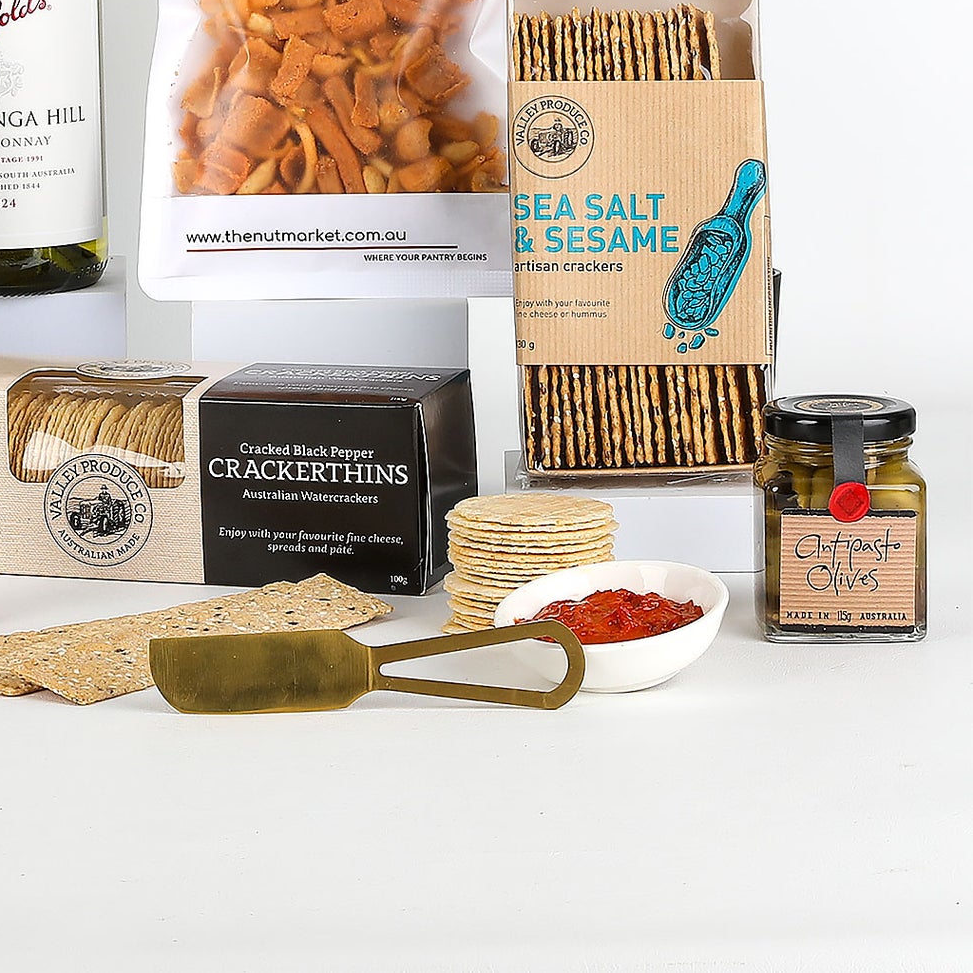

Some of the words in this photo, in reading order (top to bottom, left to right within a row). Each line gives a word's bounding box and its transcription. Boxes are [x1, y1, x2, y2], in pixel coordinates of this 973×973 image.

[47, 105, 86, 126] HILL
[515, 103, 540, 147] VALLEY
[539, 99, 588, 129] PRODUCE
[26, 155, 44, 163] 1991
[31, 167, 76, 178] AUSTRALIA
[22, 182, 41, 190] 1844
[514, 193, 576, 221] SEA
[585, 193, 665, 221] SALT
[186, 228, 407, 244] www.thenutmarket.com.au
[515, 226, 535, 253] &
[545, 226, 679, 253] SESAME
[363, 253, 394, 262] WHERE
[395, 253, 420, 262] YOUR
[421, 253, 456, 262] PANTRY
[457, 253, 488, 262] BEGINS
[514, 260, 559, 273] artisan
[563, 260, 624, 273] crackers
[515, 298, 535, 309] Enjoy
[535, 298, 553, 307] with
[555, 299, 573, 309] your
[574, 298, 611, 307] favourite
[529, 310, 559, 318] cheese
[571, 310, 608, 318] hummus
[528, 341, 535, 351] g
[240, 442, 290, 457] Cracked
[293, 444, 328, 458] Black
[331, 446, 374, 461] Pepper
[208, 457, 409, 485] CRACKERTHINS
[50, 462, 80, 521] VALLEY
[81, 459, 144, 503] PRODUCE
[242, 488, 299, 502] Australian
[300, 490, 379, 504] Watercrackers
[57, 528, 116, 560] AUSTRALIAN
[116, 532, 141, 557] MADE
[219, 527, 247, 539] Enjoy
[248, 528, 271, 539] with
[272, 531, 297, 543] your
[298, 529, 345, 542] favourite
[346, 532, 366, 545] fine
[368, 533, 404, 546] cheese,
[267, 542, 306, 555] spreads
[308, 543, 328, 554] and
[806, 561, 879, 597] Olives
[786, 611, 813, 619] MADE
[818, 611, 829, 620] IN
[860, 612, 907, 621] AUSTRALIA
